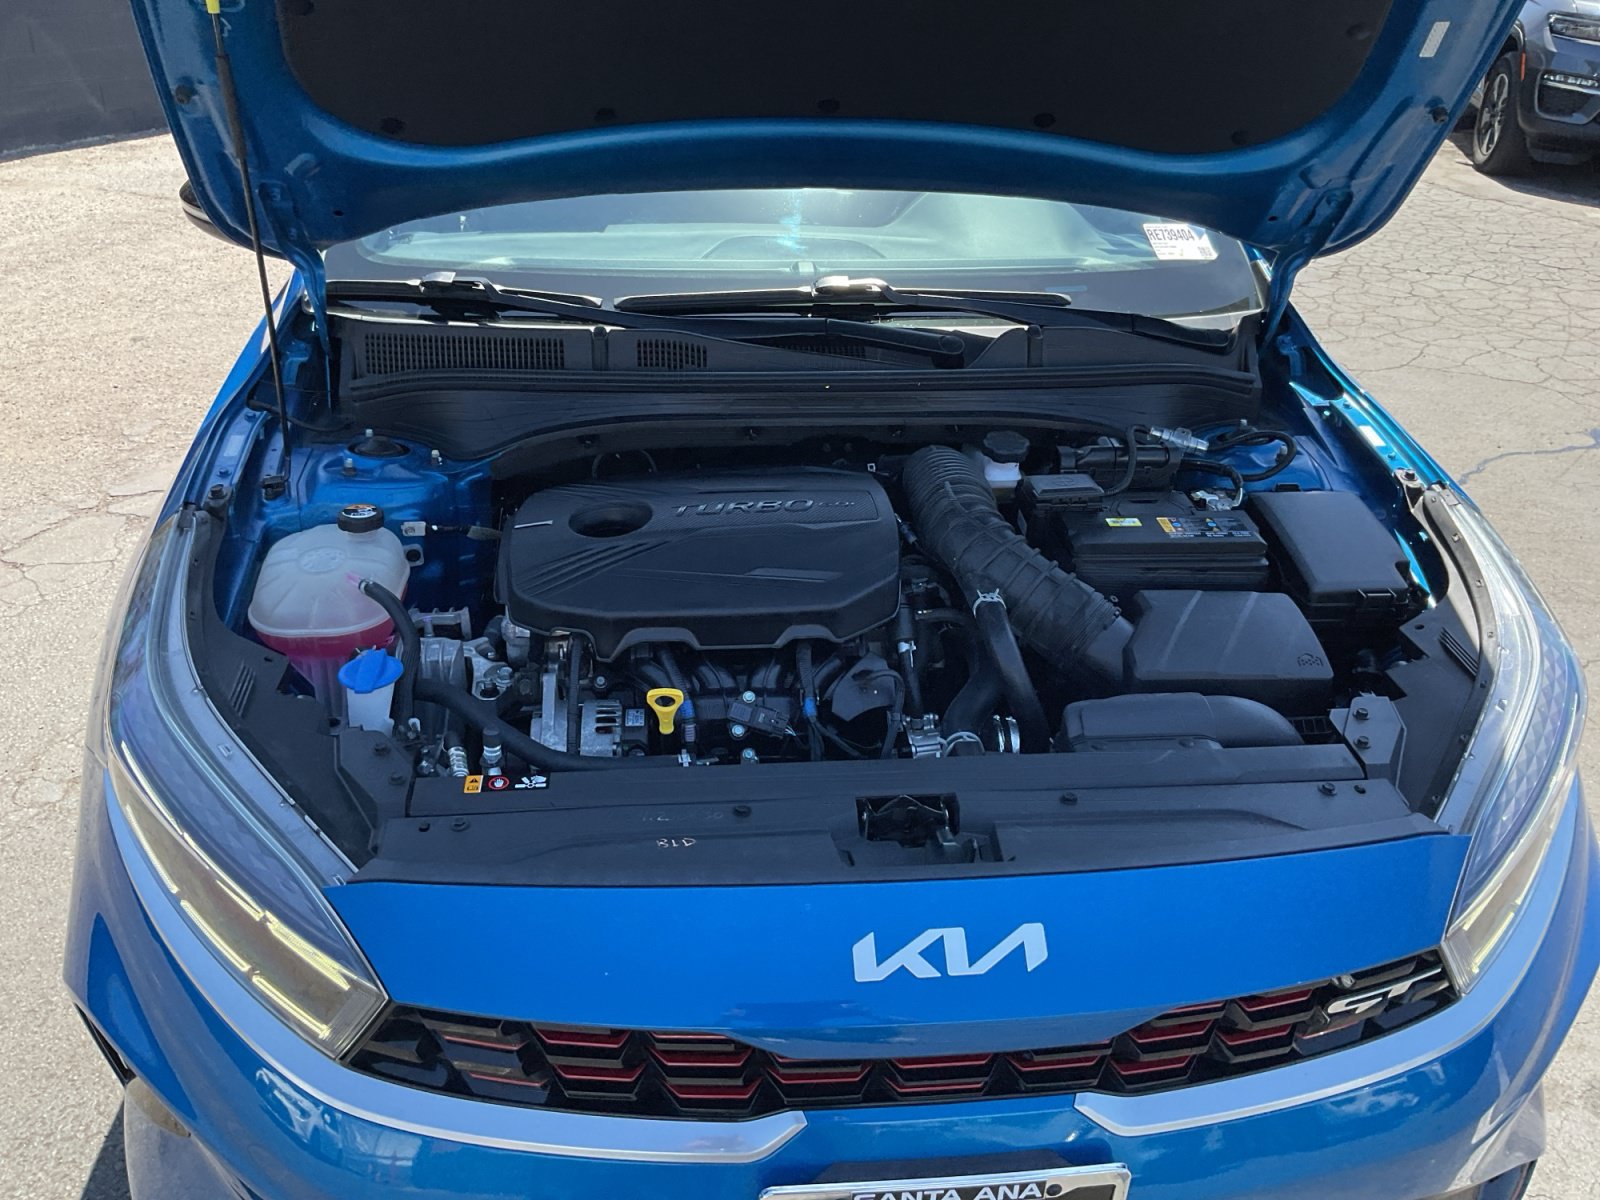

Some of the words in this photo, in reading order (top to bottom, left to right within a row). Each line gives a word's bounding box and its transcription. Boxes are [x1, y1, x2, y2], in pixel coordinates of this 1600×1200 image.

[1146, 228, 1195, 241] RE739404
[672, 500, 814, 517] TURBO
[852, 922, 1048, 982] KIA
[1327, 967, 1442, 1014] GT
[973, 1183, 1042, 1200] ANA
